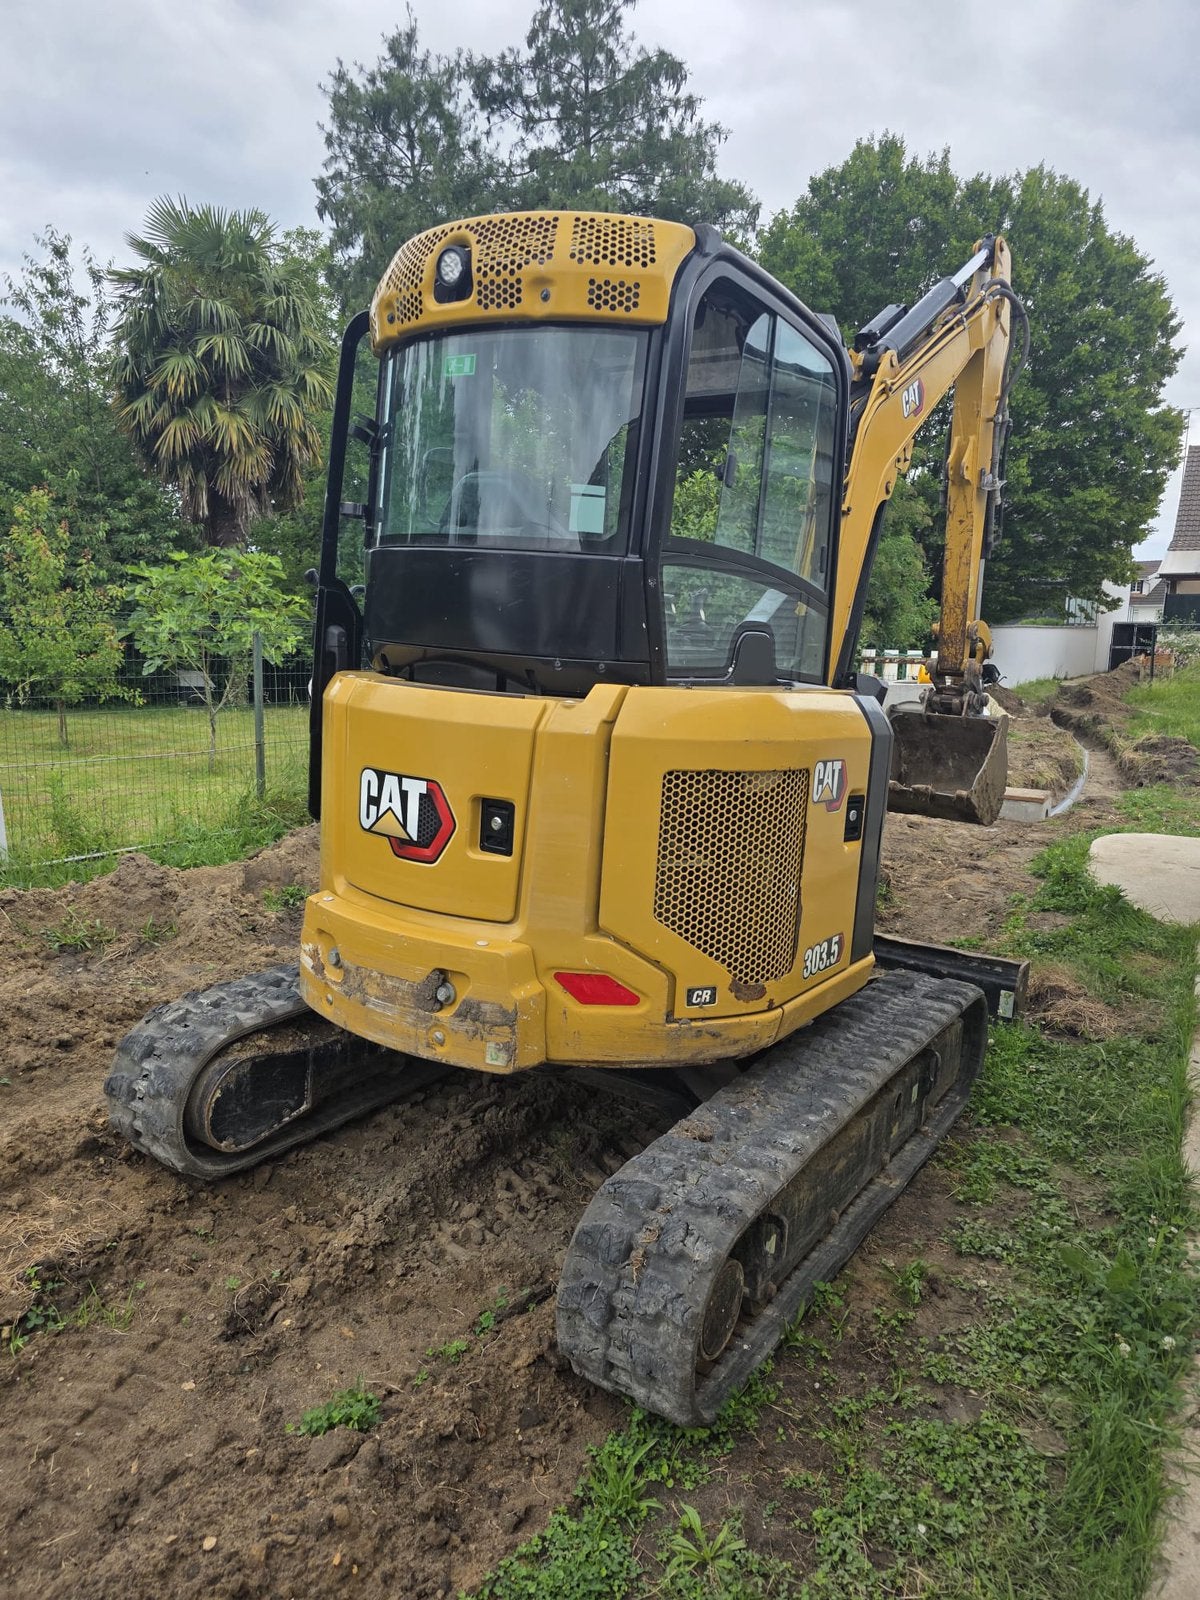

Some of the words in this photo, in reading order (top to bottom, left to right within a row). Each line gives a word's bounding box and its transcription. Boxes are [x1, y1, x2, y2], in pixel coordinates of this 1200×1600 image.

[902, 380, 919, 417] CAT
[812, 761, 842, 802] CAT
[360, 768, 427, 841] CAT
[803, 936, 840, 979] 303.5
[692, 990, 711, 1004] CR
